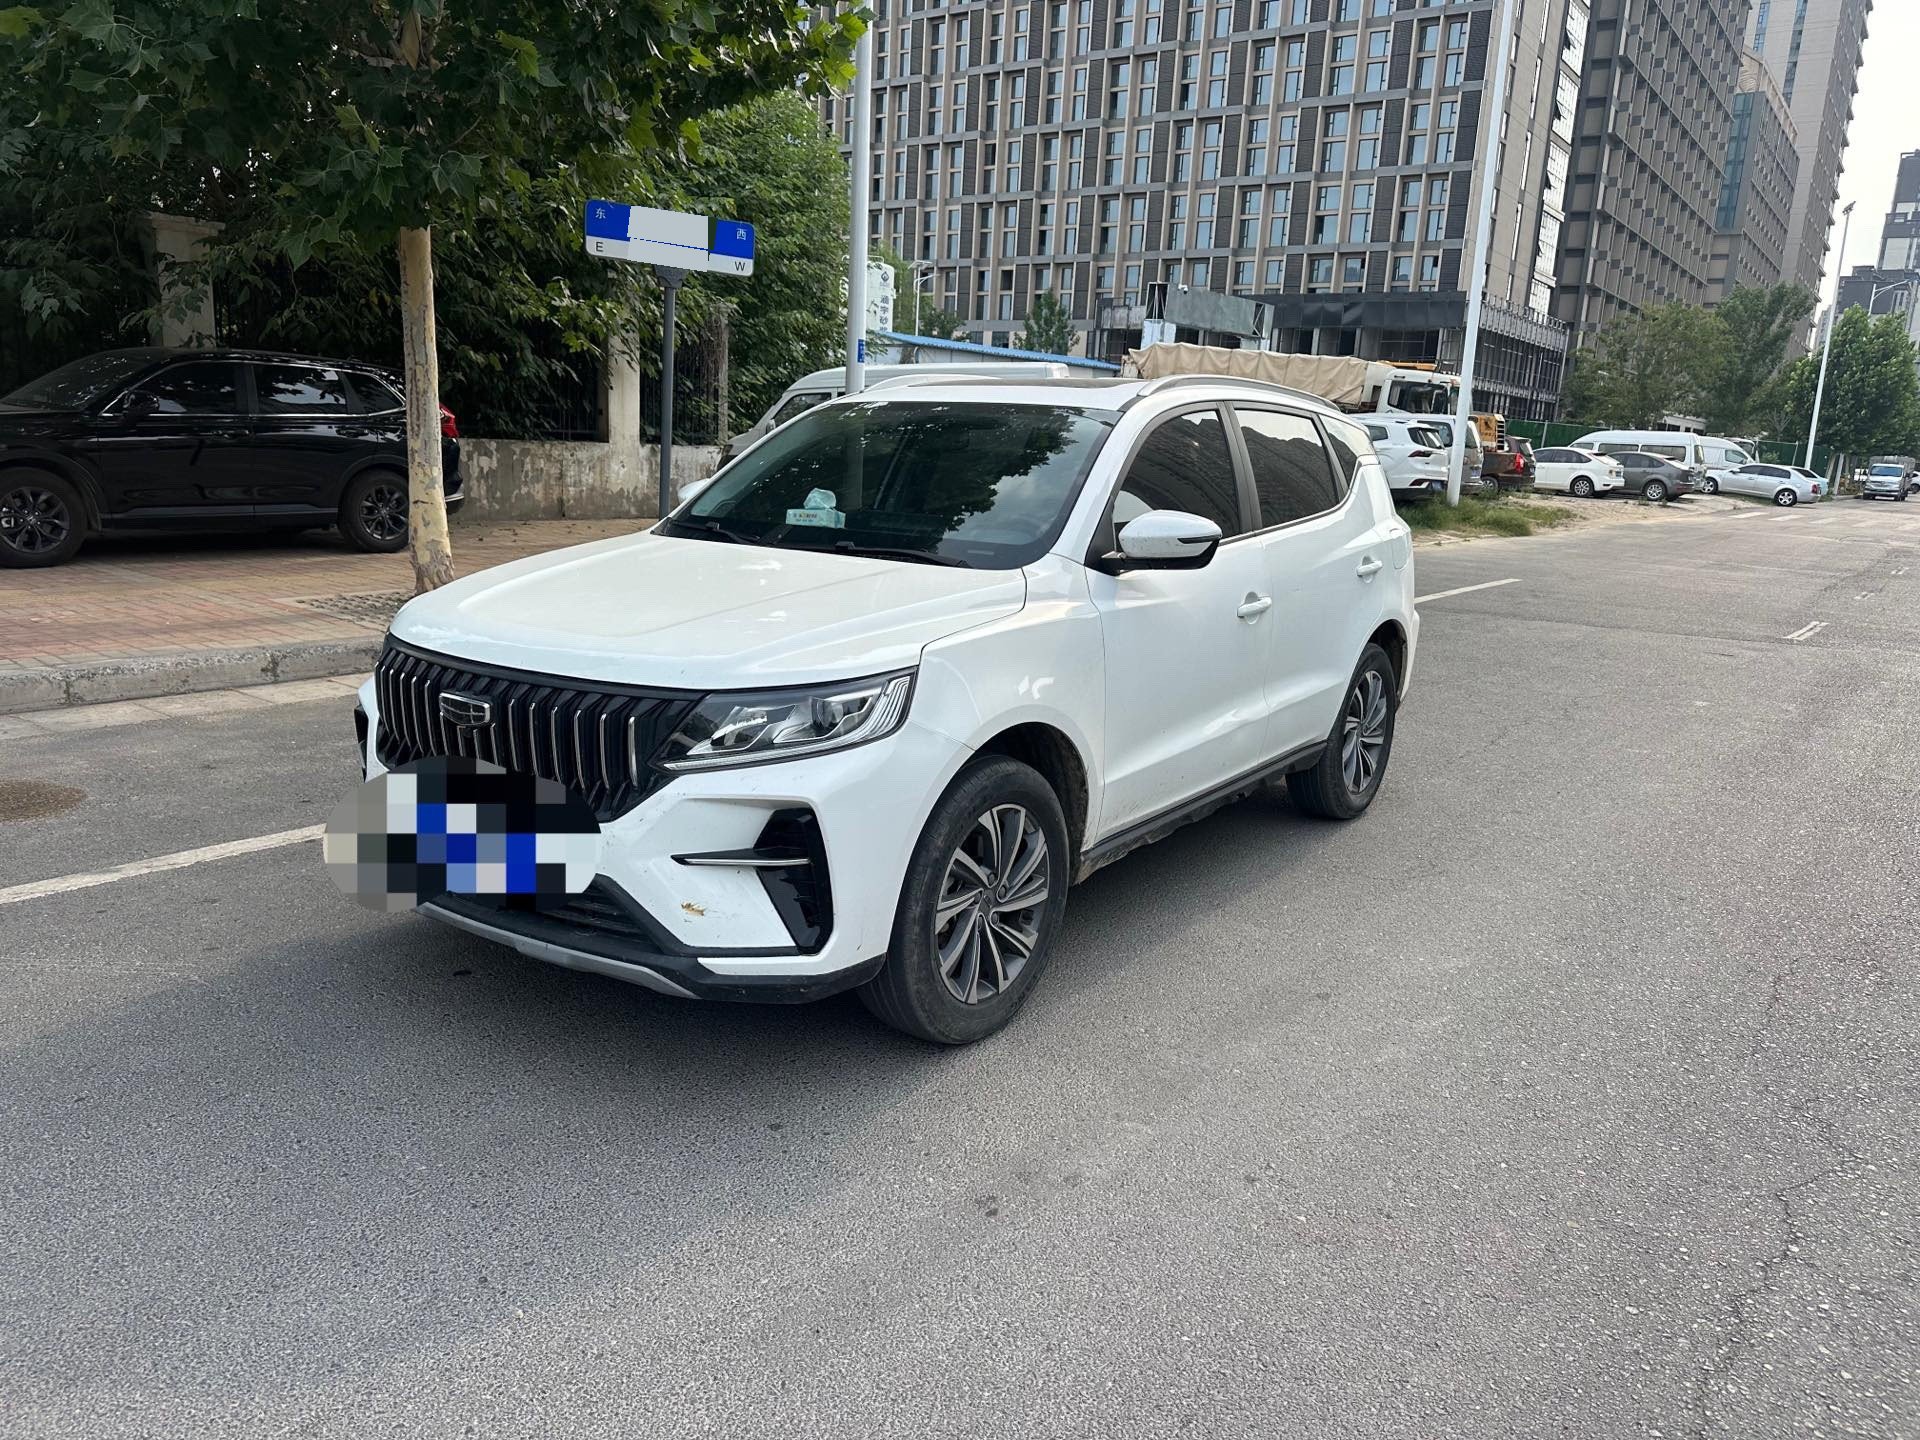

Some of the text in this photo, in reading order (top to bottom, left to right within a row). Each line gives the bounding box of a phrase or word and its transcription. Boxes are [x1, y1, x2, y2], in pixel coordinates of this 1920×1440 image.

[595, 207, 747, 240] 东 西
[595, 242, 746, 271] E W
